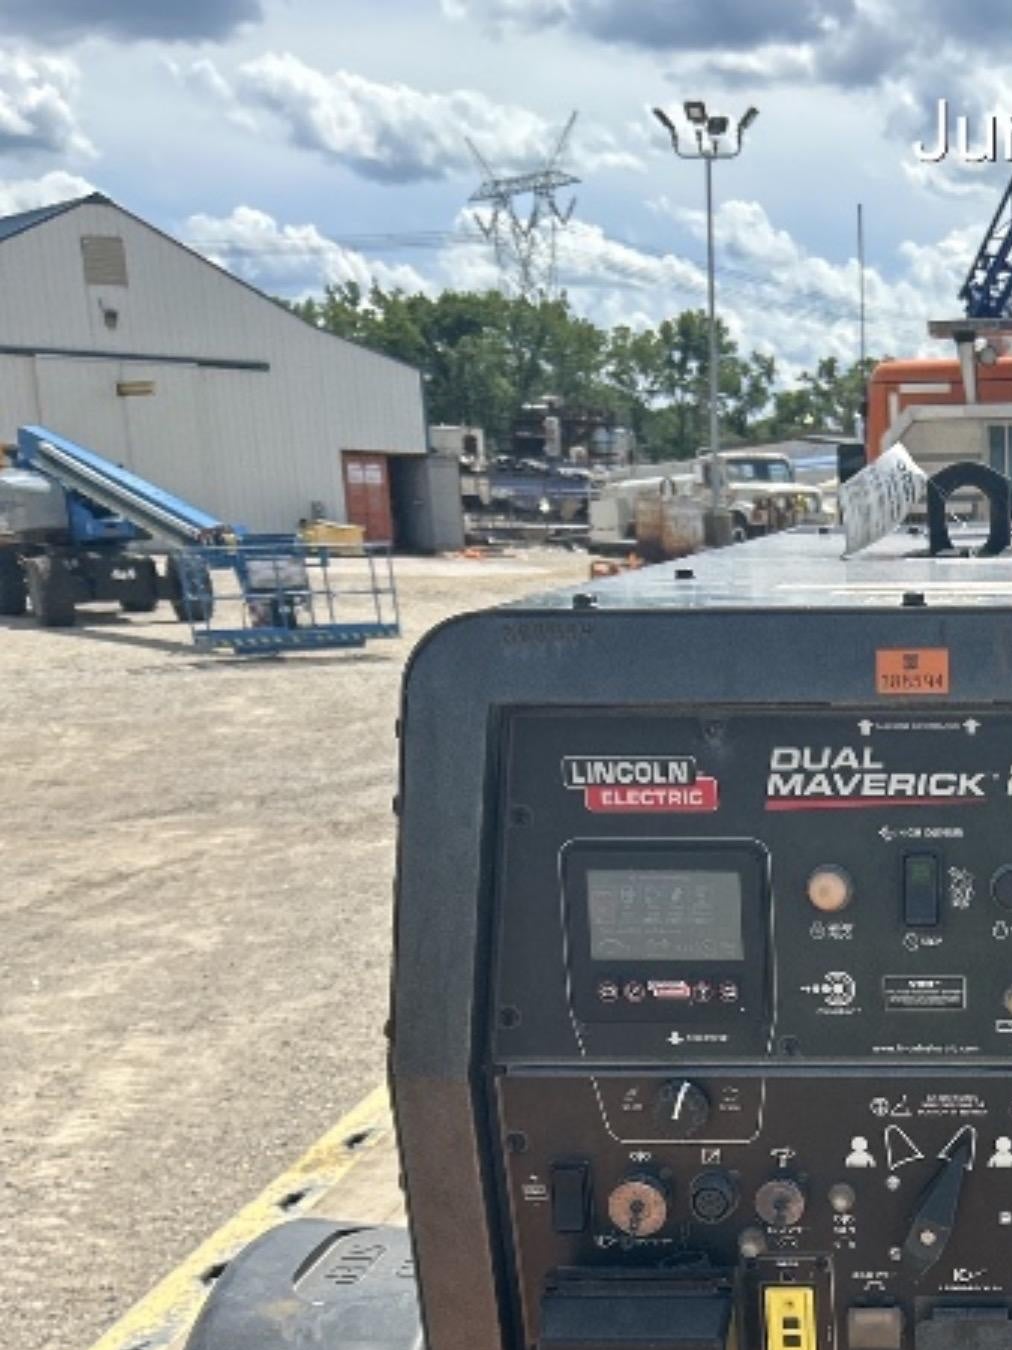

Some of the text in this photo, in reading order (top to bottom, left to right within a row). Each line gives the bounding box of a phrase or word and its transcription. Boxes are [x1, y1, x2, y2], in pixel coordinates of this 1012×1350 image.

[769, 746, 883, 770] DUAL
[571, 761, 688, 784] LINCOLN
[767, 772, 985, 796] MAVERICK
[602, 791, 703, 806] ELECTRIC
